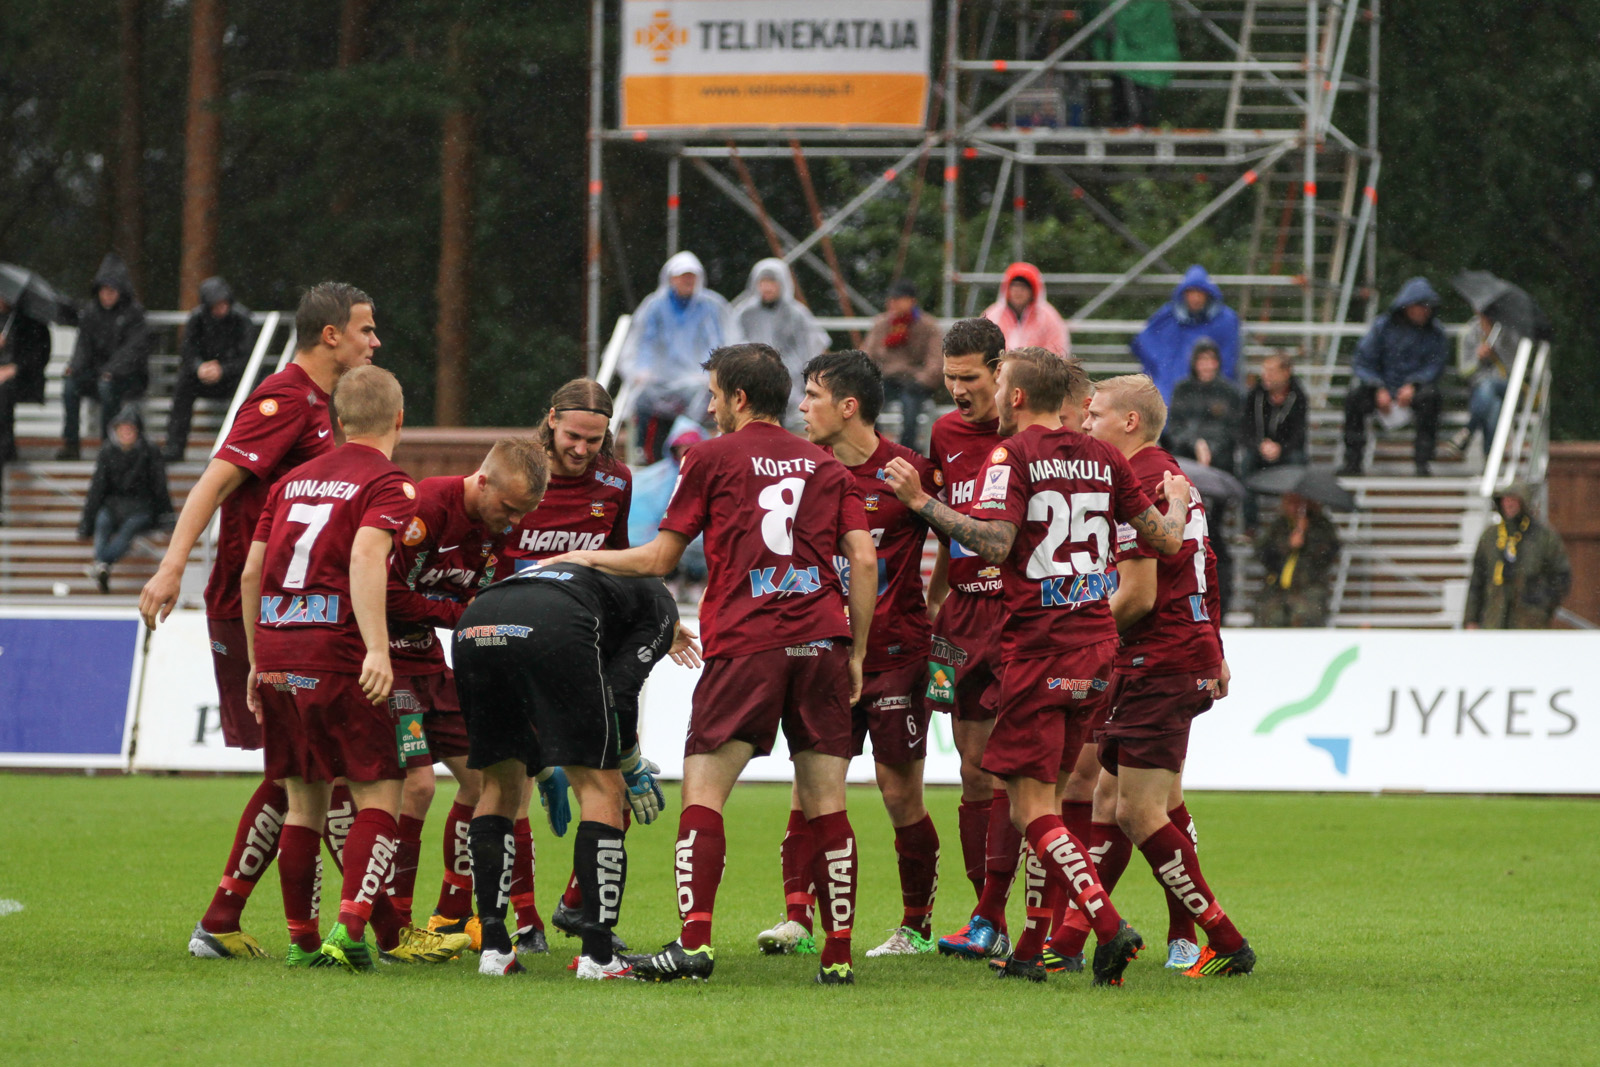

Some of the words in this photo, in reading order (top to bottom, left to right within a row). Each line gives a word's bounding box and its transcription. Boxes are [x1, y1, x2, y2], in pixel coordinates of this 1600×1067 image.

[698, 20, 918, 51] TELINEKATAJA
[284, 479, 360, 501] INNANEN
[752, 457, 816, 477] KORTE
[1029, 459, 1112, 486] MARKKULA
[518, 529, 606, 552] HARVIA
[758, 477, 806, 556] 8
[1026, 490, 1111, 580] 25
[282, 503, 334, 589] 7
[749, 563, 822, 600] KARI
[260, 594, 339, 628] KARI
[465, 624, 534, 639] INTERSPORT
[906, 714, 917, 736] 6
[1374, 687, 1579, 738] JYKES
[354, 834, 396, 905] TOTAL
[596, 838, 625, 924] TOTAL
[675, 829, 698, 925] OTAL
[825, 838, 853, 932] TOTAL
[1046, 834, 1104, 919] TOTAL
[1159, 849, 1211, 917] OTAL
